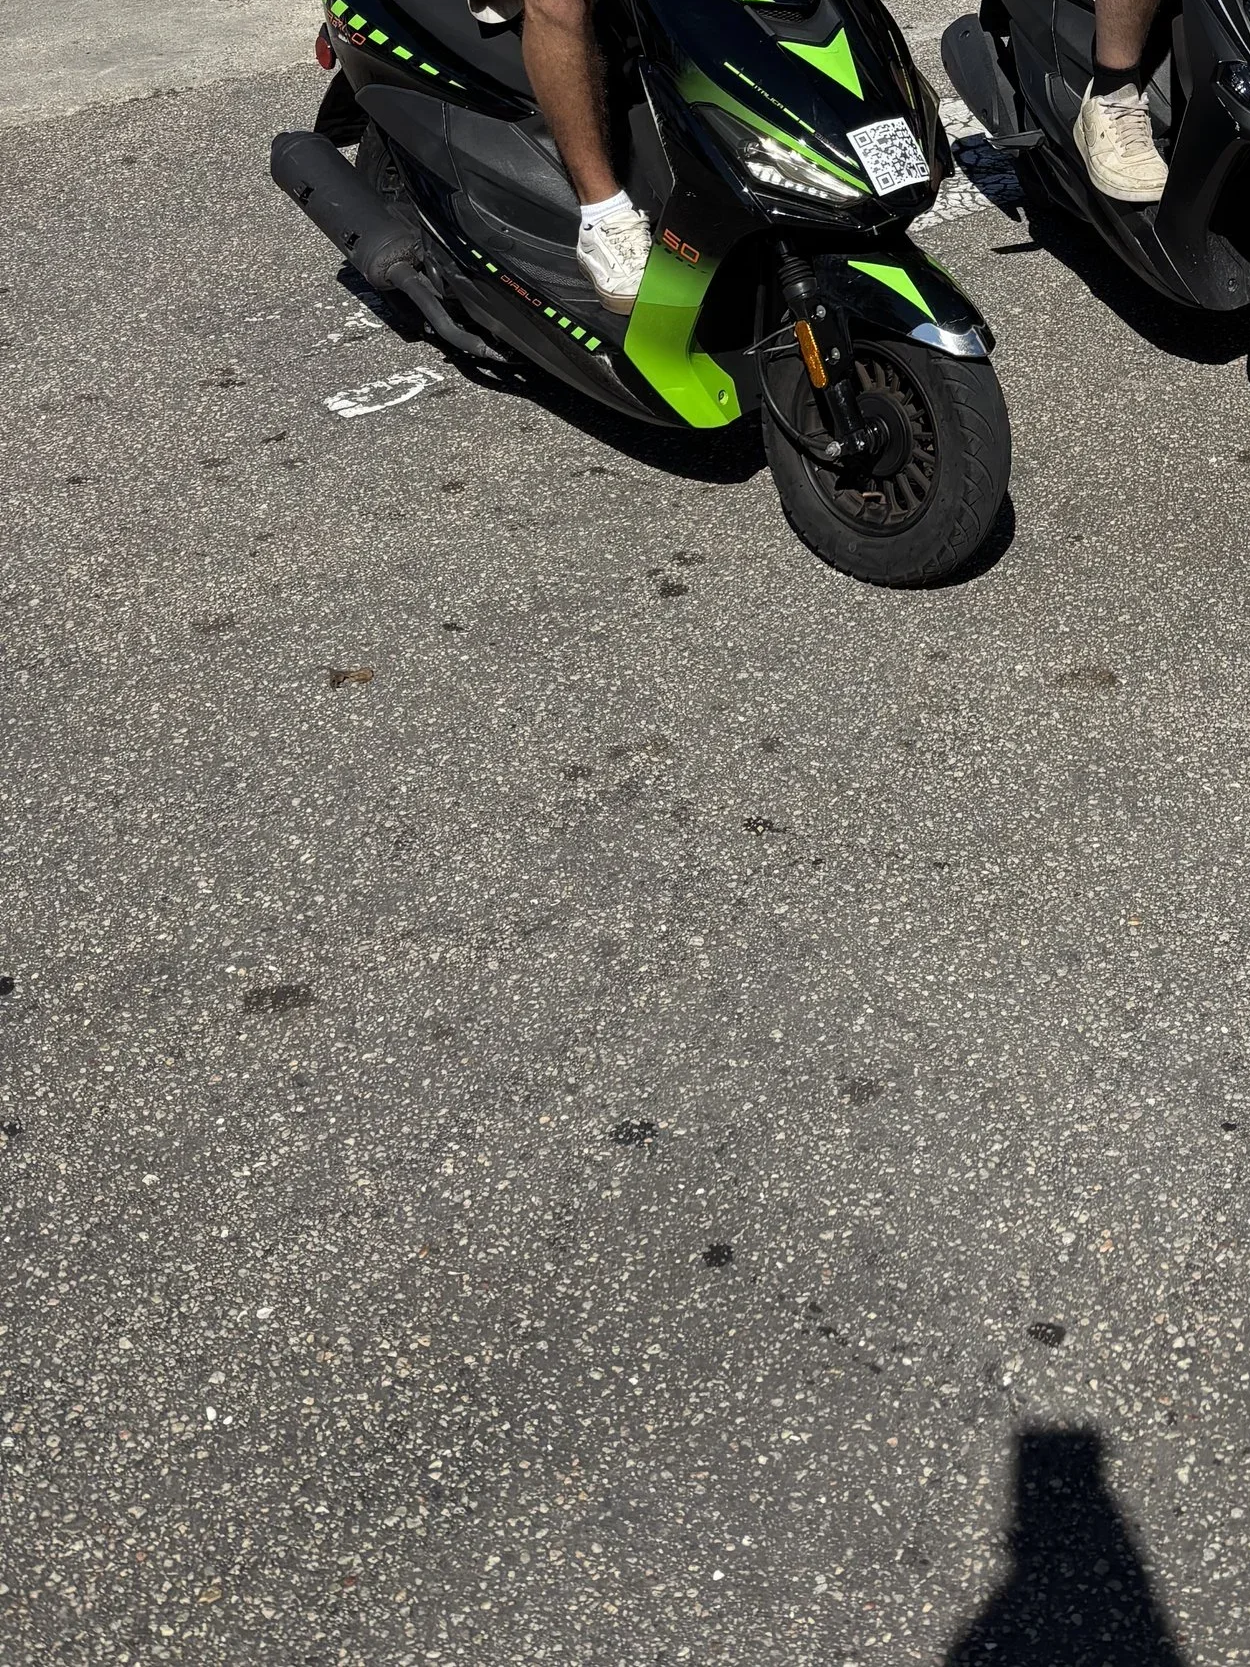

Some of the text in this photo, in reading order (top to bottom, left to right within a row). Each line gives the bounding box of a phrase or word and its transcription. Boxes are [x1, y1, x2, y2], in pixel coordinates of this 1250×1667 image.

[754, 84, 785, 110] ITALICA
[662, 228, 700, 264] 50
[500, 274, 542, 307] DIABLO
